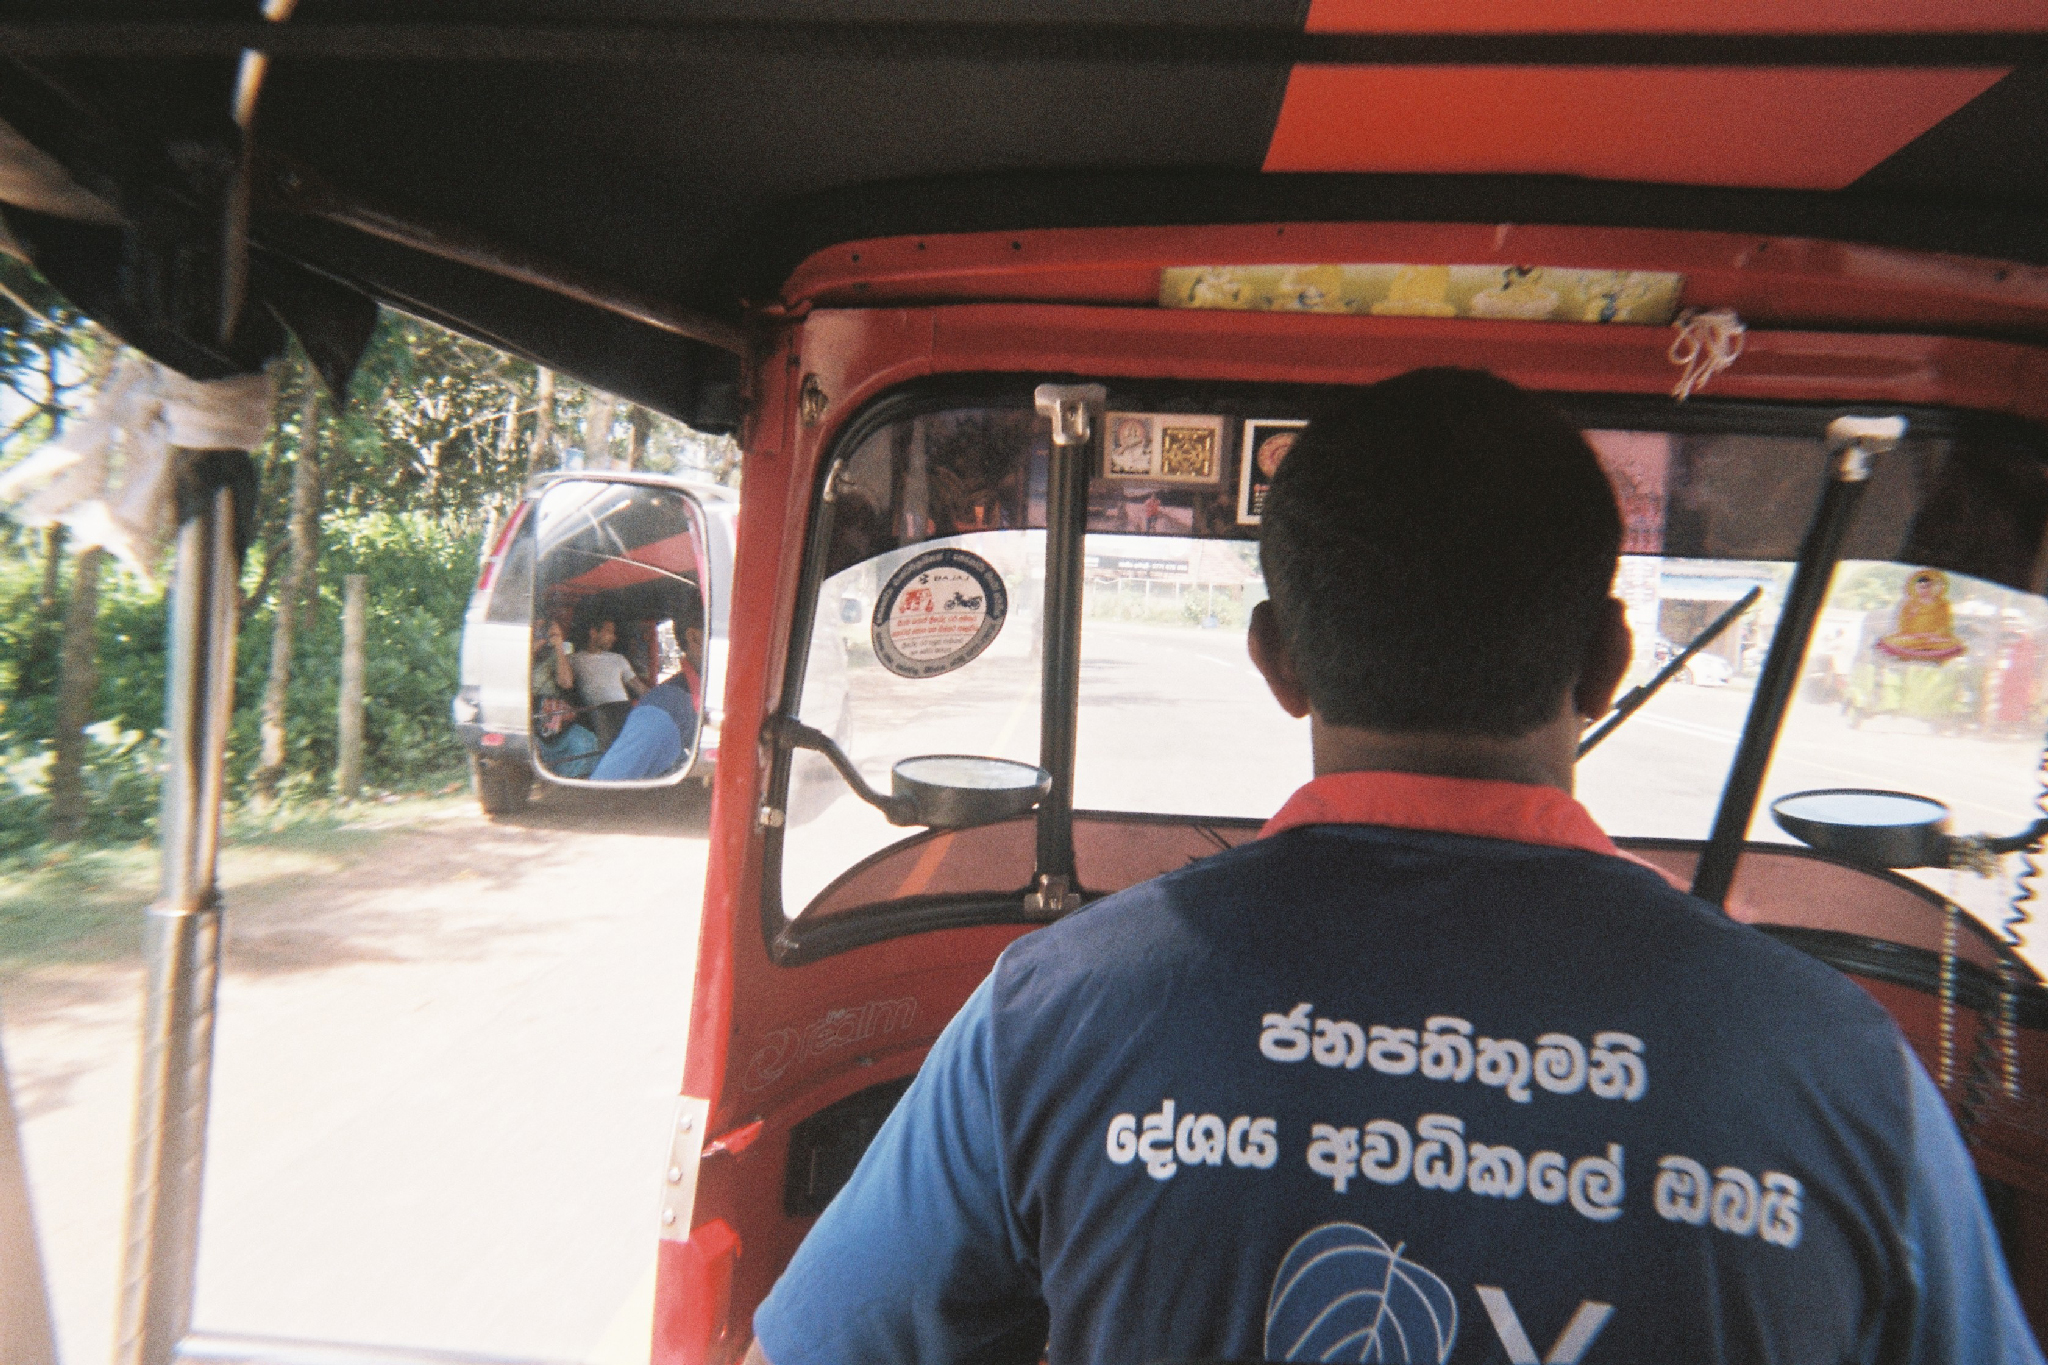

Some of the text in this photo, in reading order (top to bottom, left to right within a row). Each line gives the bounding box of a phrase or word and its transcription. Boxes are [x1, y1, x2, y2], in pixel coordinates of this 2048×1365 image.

[1258, 1002, 1648, 1104] ජනපතිතුමනි
[1106, 1098, 1803, 1248] දේශය අවධිකලේ ඔබයි
